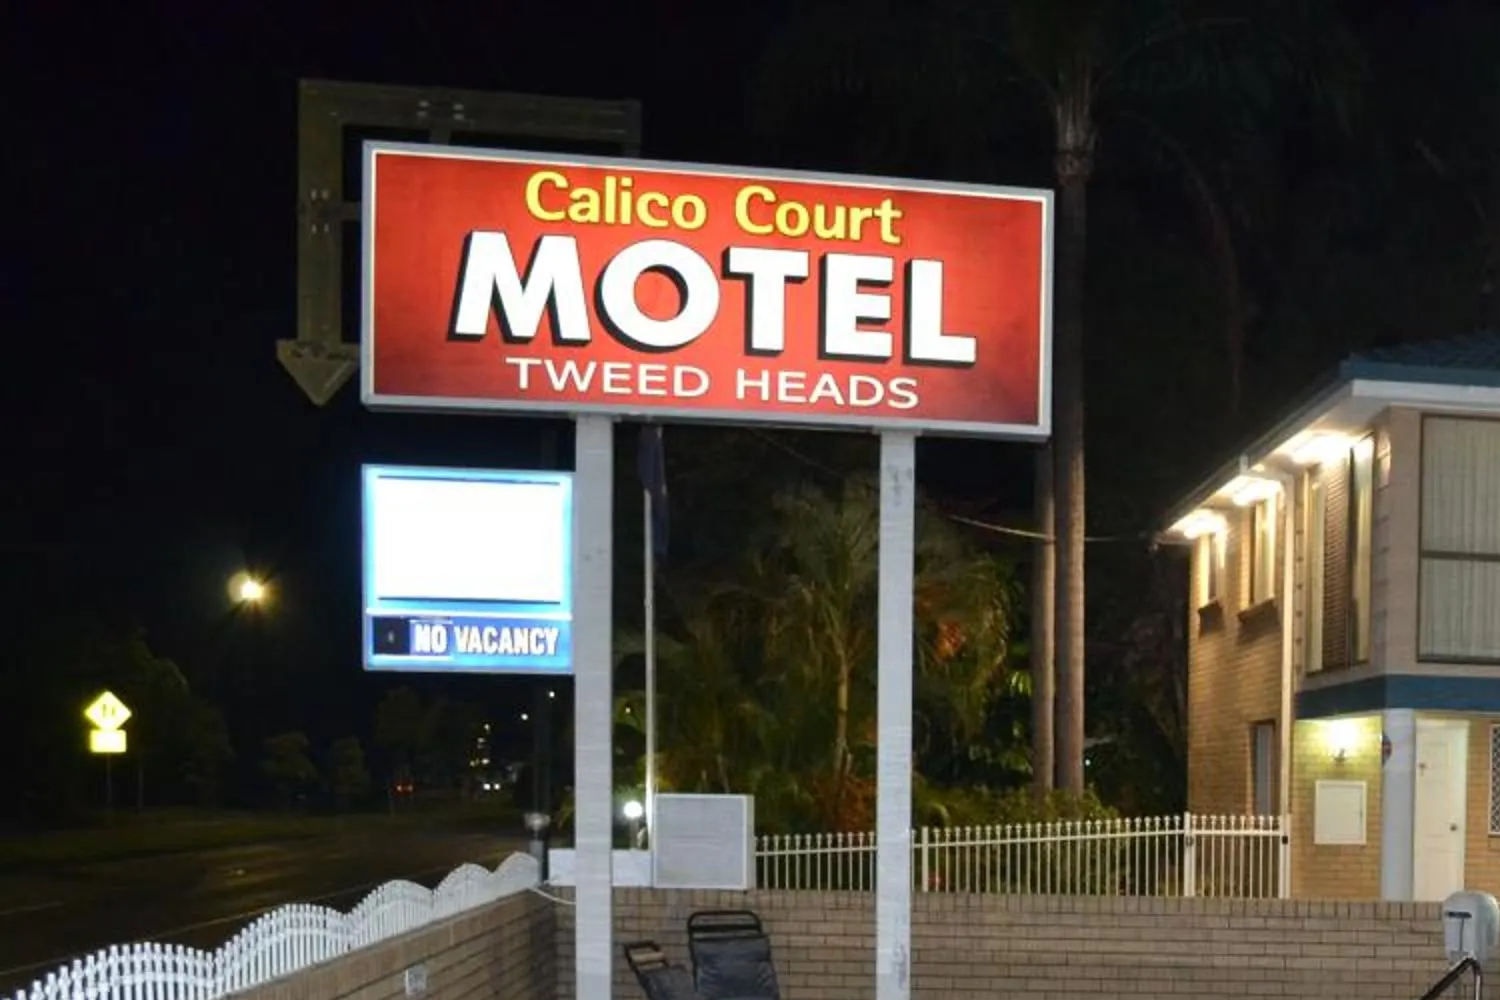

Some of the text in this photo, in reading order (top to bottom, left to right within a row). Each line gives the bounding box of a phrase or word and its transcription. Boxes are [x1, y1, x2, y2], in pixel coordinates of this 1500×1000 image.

[524, 170, 903, 245] Calico Court
[446, 230, 978, 366] MOTEL
[505, 356, 921, 410] TWEED HEADS
[413, 623, 560, 656] NO VACANCY
